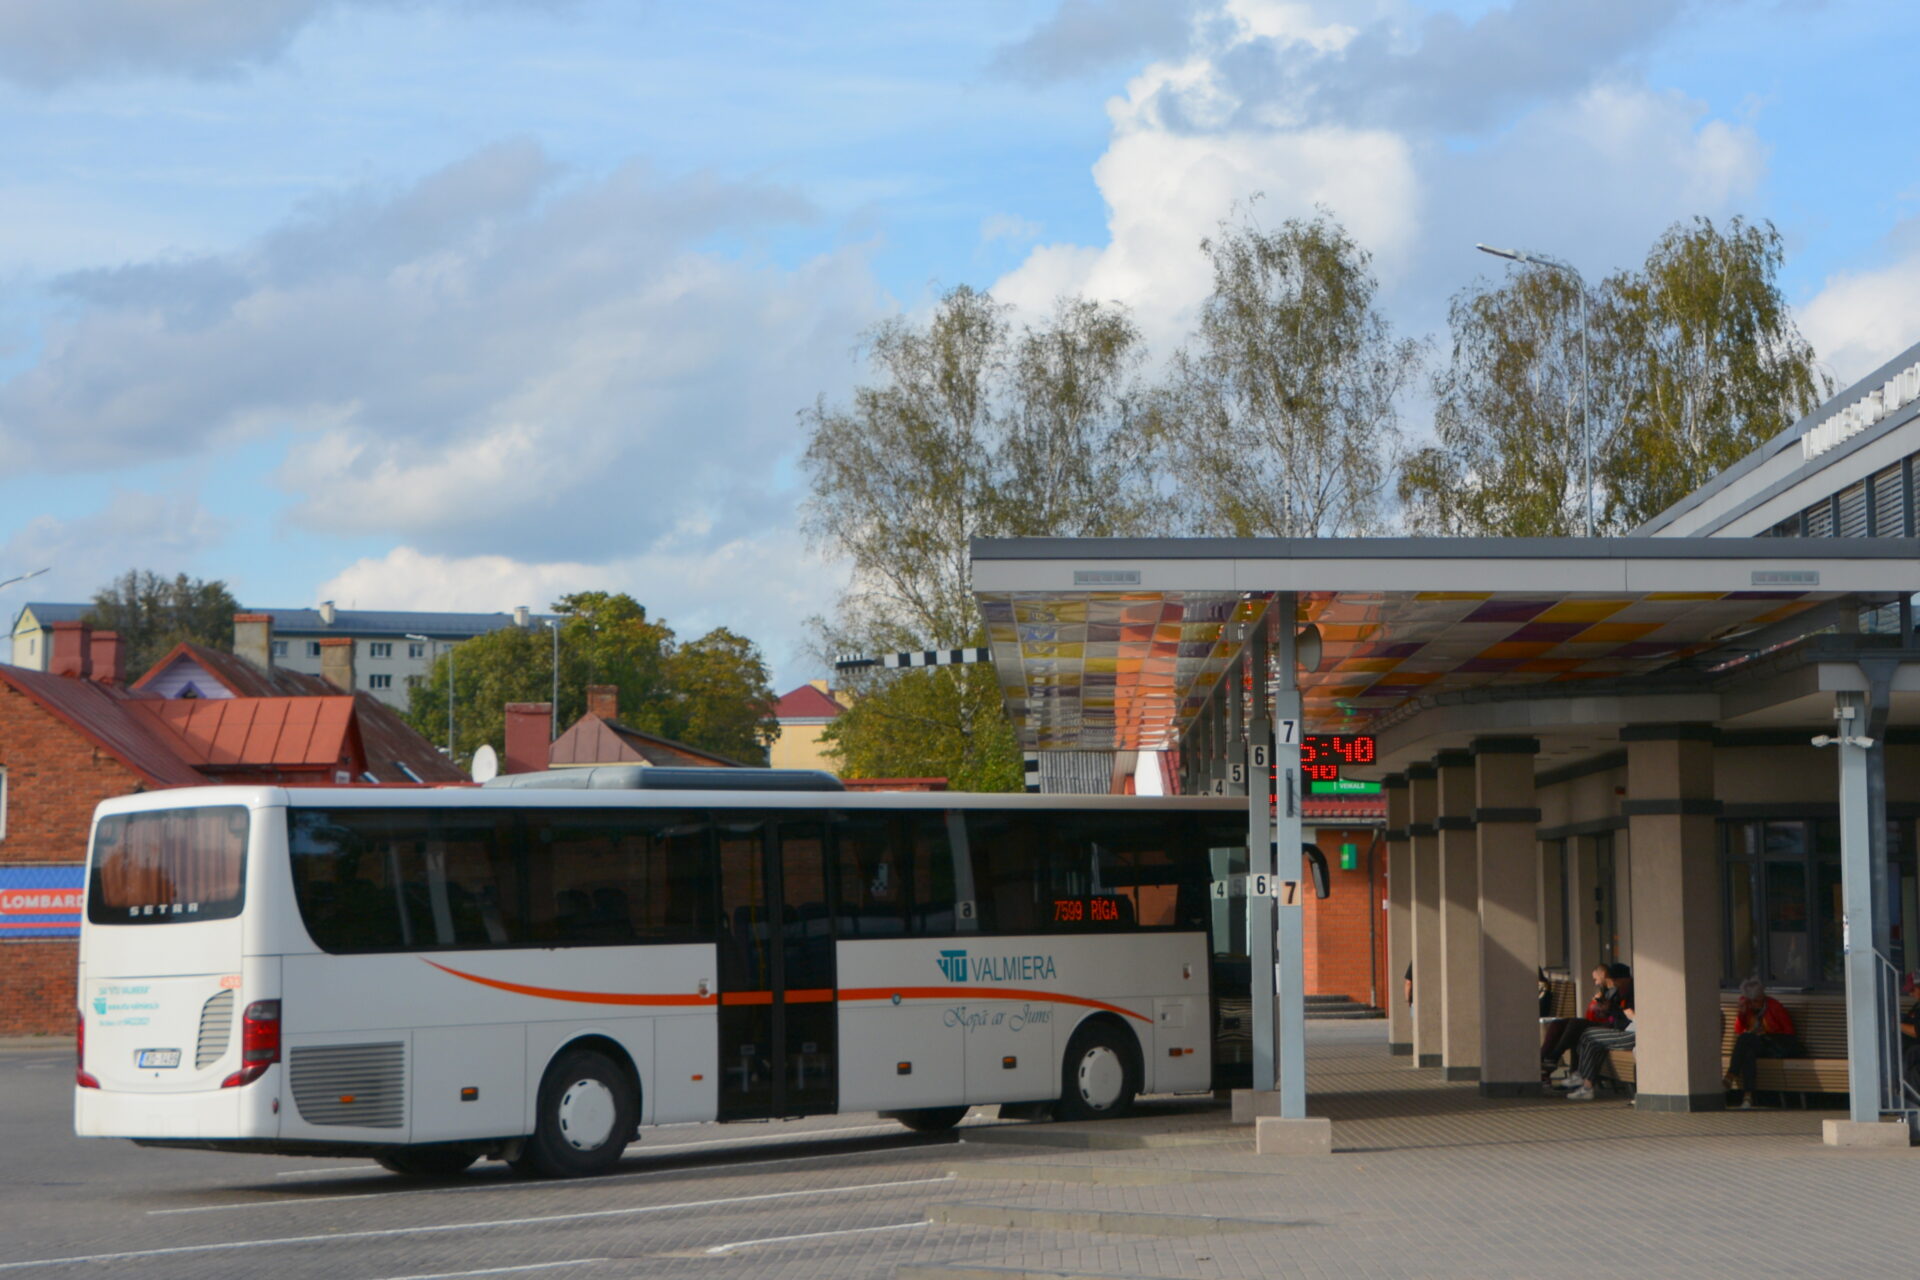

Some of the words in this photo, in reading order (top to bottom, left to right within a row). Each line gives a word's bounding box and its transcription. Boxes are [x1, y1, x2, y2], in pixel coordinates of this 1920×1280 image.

[1283, 721, 1294, 743] 7
[1255, 746, 1264, 766] 6
[1232, 764, 1241, 782] 5
[1215, 780, 1223, 796] 4
[1216, 881, 1224, 898] 4
[1256, 875, 1266, 895] 6
[1284, 882, 1296, 904] 7
[129, 902, 199, 918] SETRA
[1054, 899, 1083, 921] 7599
[1091, 897, 1118, 920] RĪGA
[970, 955, 1057, 982] VALMIERA
[943, 1006, 989, 1034] Kopā
[991, 1011, 1007, 1026] ar
[1008, 1003, 1052, 1032] Jums
